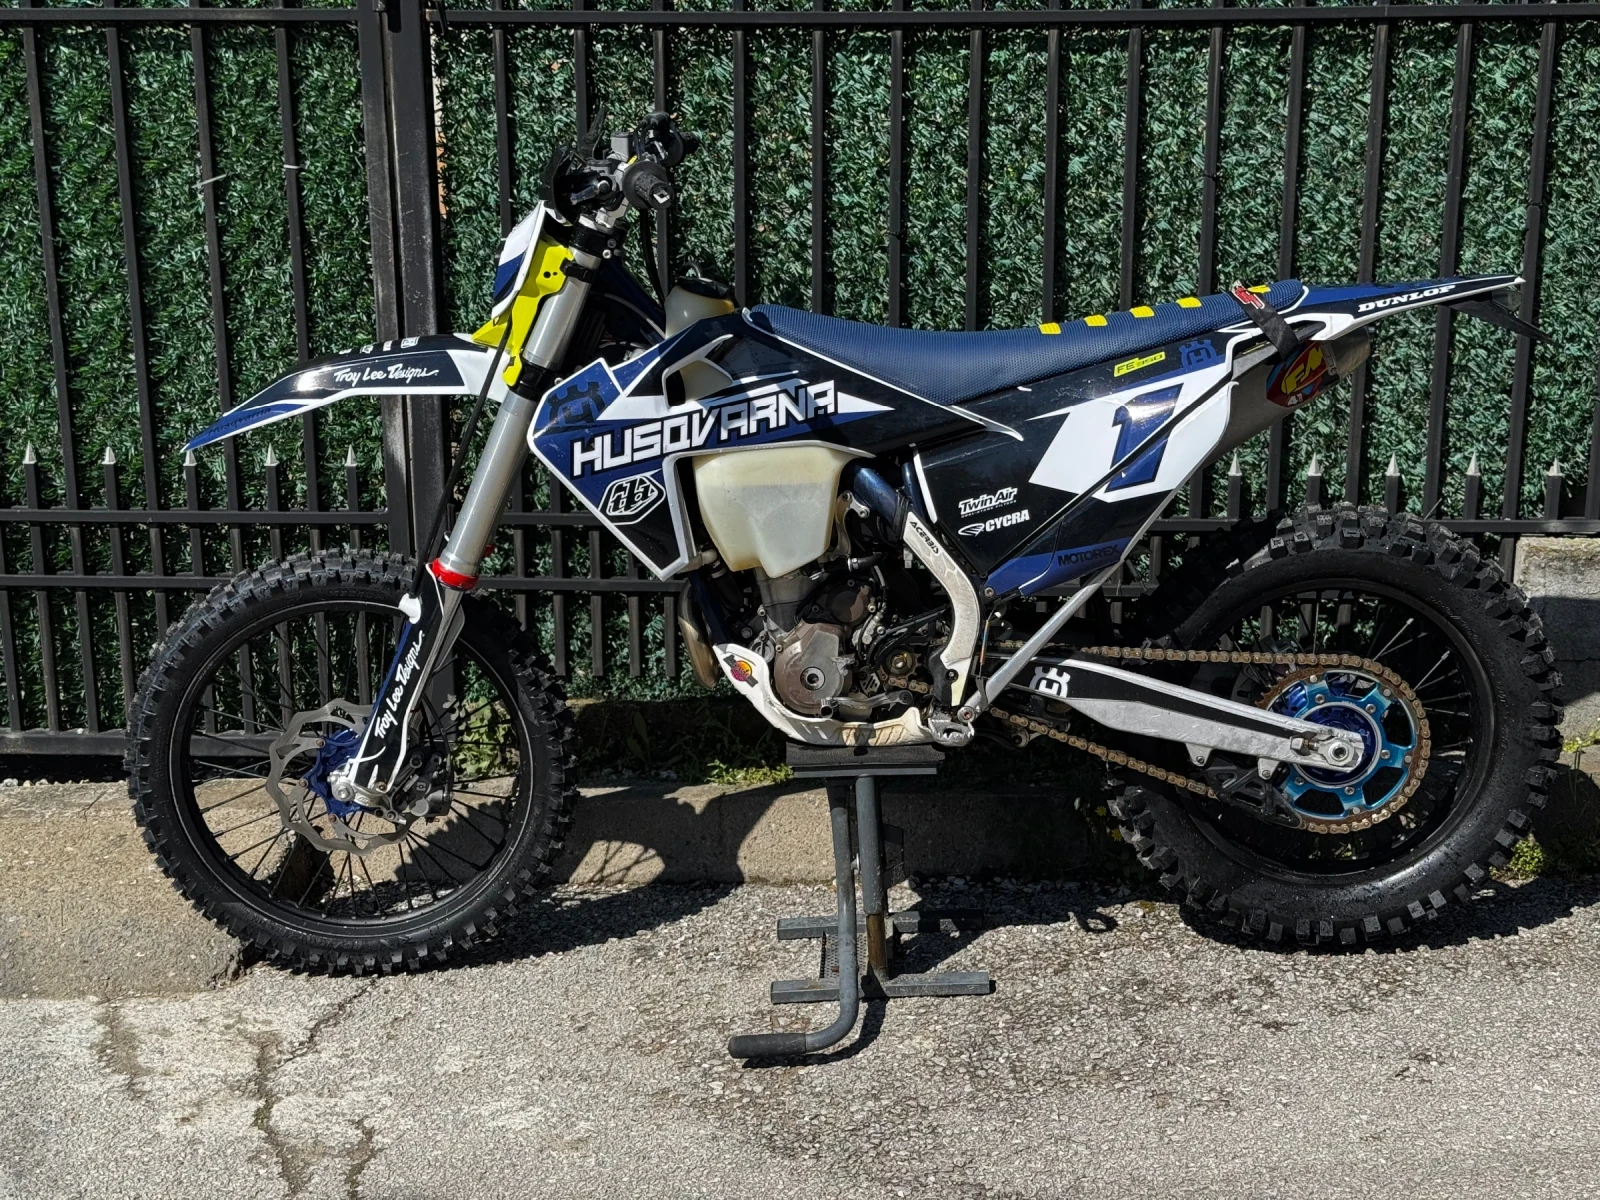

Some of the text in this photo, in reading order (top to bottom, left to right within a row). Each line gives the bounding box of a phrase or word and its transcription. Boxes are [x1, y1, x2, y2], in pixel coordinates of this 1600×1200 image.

[1358, 284, 1456, 313] DUNLOP
[333, 363, 439, 387] Troy Lee Designs
[573, 379, 835, 477] HUSQVARNA
[985, 509, 1030, 532] CYCRA
[909, 521, 939, 554] ACERBIS
[1057, 544, 1119, 566] MOTOREX
[374, 630, 423, 739] Troy Lee Designs
